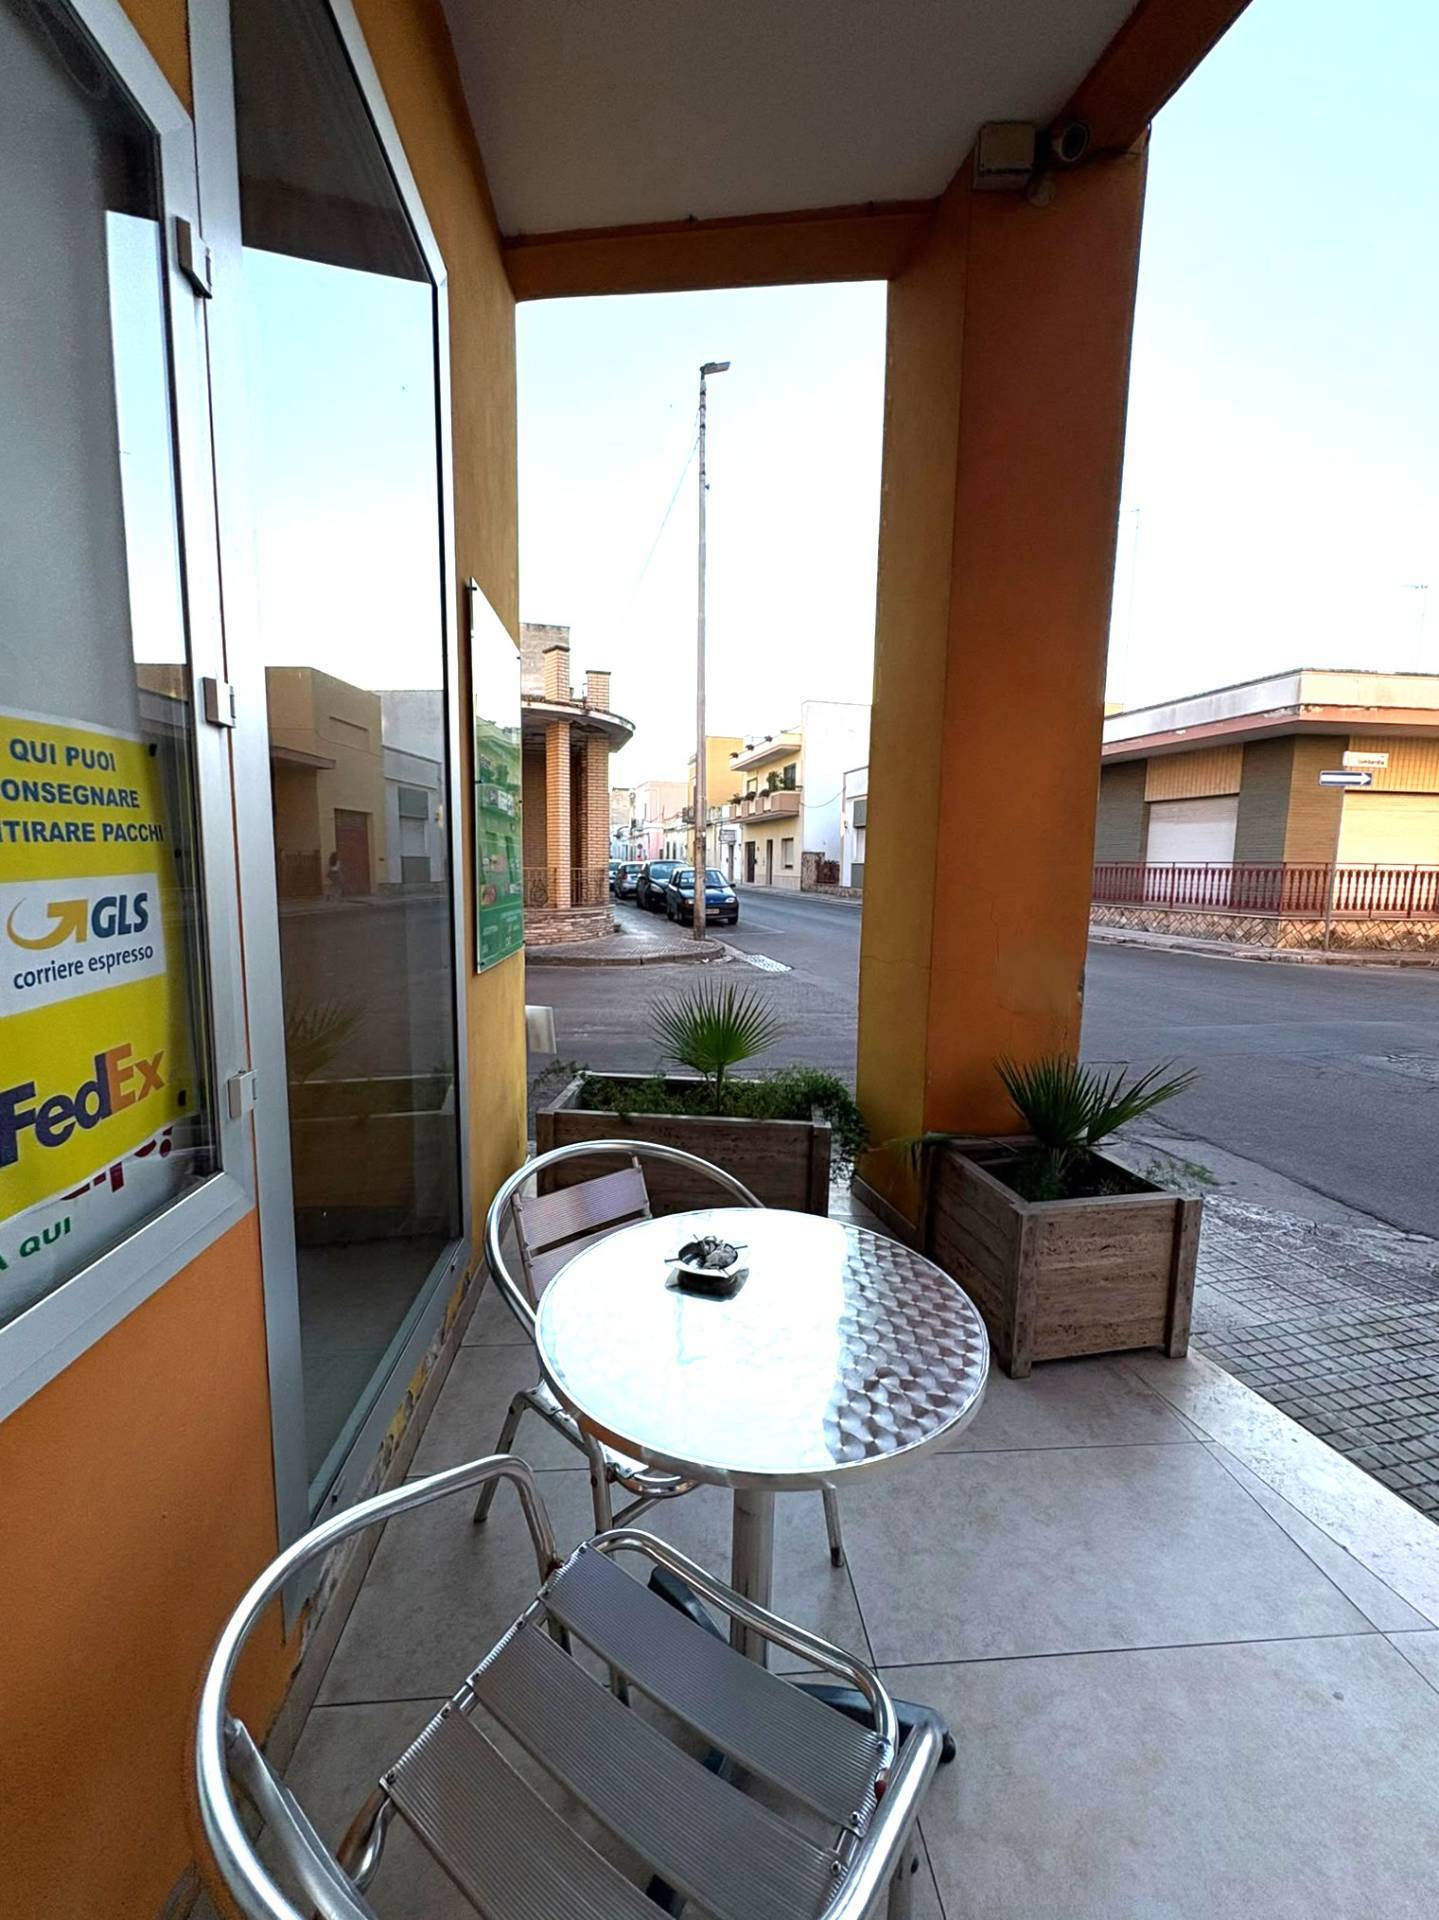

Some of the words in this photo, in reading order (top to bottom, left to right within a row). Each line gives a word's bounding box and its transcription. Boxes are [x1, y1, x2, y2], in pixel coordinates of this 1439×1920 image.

[9, 738, 57, 765] QUI
[65, 746, 117, 772] PUOI
[0, 778, 141, 808] ONSEGNARE
[102, 822, 165, 842] PACCHI
[91, 892, 149, 938] GLS
[13, 959, 84, 990] corriere
[88, 945, 154, 974] espresso
[0, 1042, 166, 1168] FedEx
[19, 1216, 71, 1258] QUI
